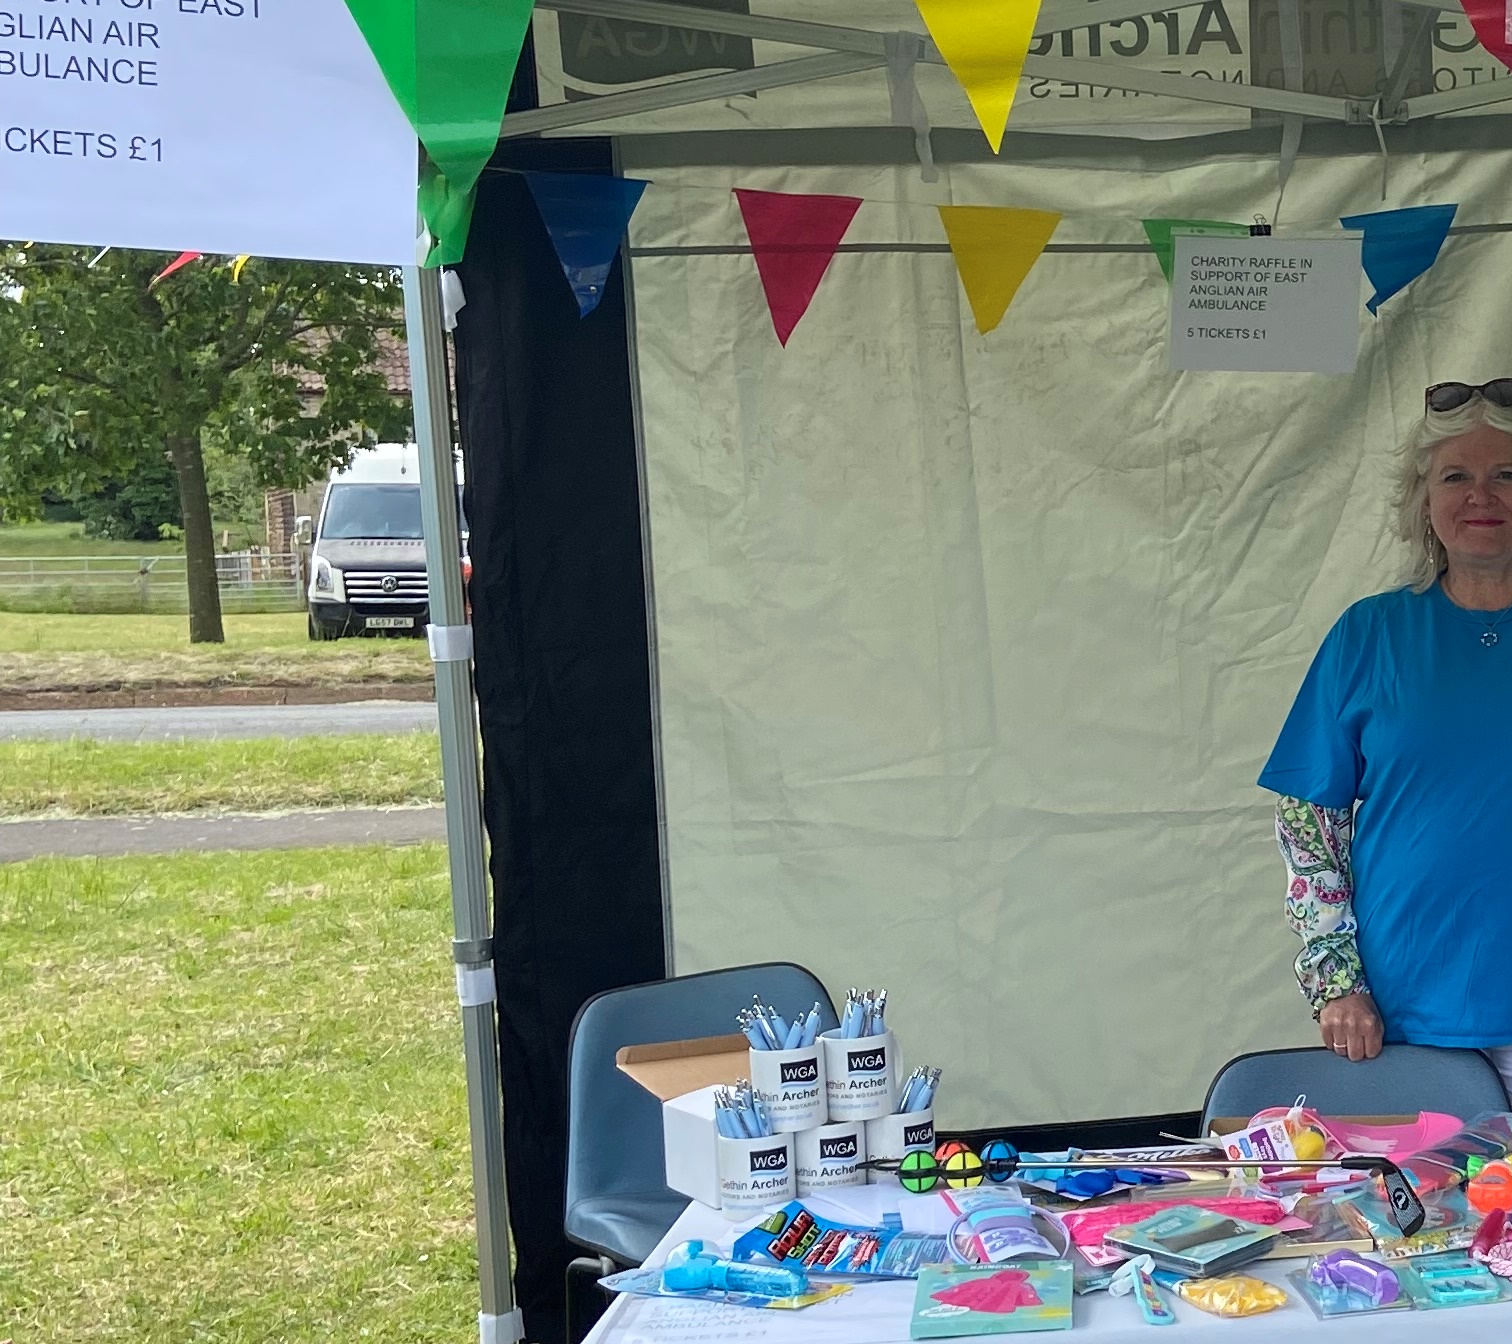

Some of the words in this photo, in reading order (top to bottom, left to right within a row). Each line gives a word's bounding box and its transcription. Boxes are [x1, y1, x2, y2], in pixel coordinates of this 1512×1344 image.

[102, 20, 161, 49] AIR
[128, 136, 162, 163] £1
[1191, 256, 1246, 269] CHARITY
[1249, 257, 1297, 269] RAFFLE
[1300, 258, 1313, 269] IN
[1190, 270, 1251, 282] SUPPORT
[1253, 272, 1271, 283] OF
[1274, 272, 1308, 283] EAST
[1189, 284, 1245, 297] ANGLIAN
[1247, 286, 1268, 297] AIR
[1188, 298, 1267, 311] AMBULANCE
[1187, 327, 1195, 338] 5
[1197, 328, 1250, 340] TICKETS
[1253, 330, 1267, 340] £1
[851, 1054, 884, 1069] WGA
[784, 1064, 817, 1081] WGA
[849, 1077, 887, 1090] Archer
[782, 1087, 820, 1102] Archer
[907, 1126, 933, 1143] WGA
[823, 1141, 856, 1156] WGA
[753, 1153, 786, 1169] WGA
[750, 1175, 789, 1190] Archer
